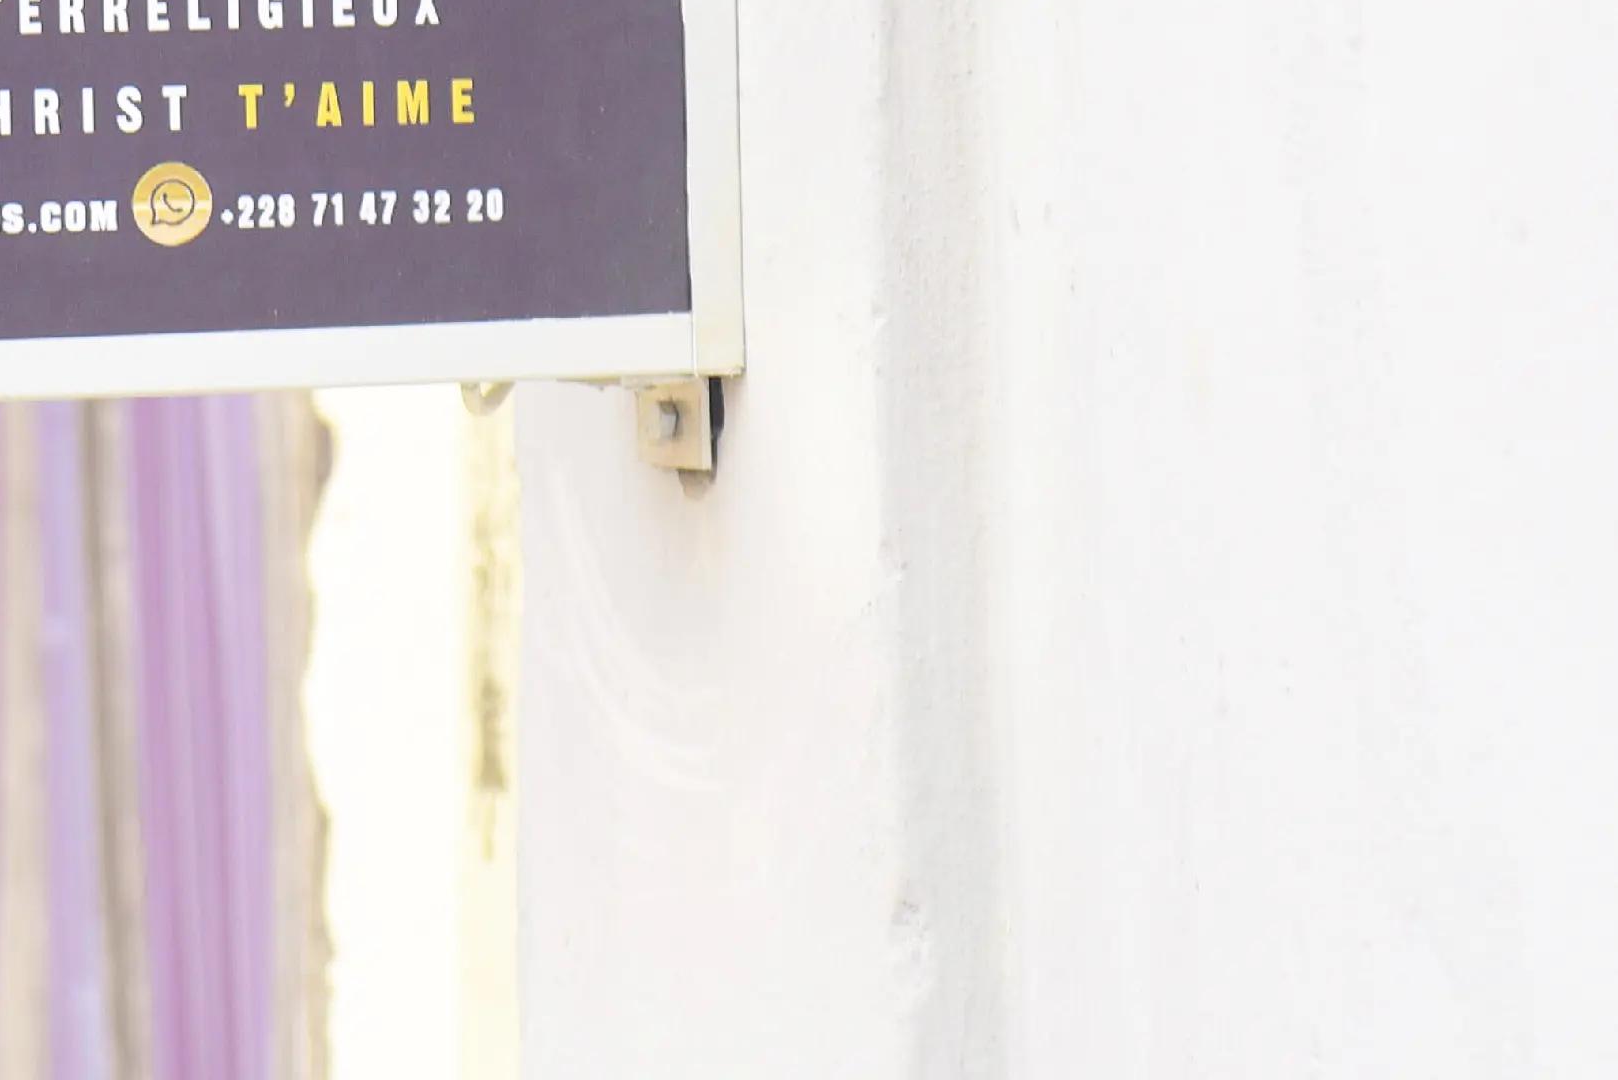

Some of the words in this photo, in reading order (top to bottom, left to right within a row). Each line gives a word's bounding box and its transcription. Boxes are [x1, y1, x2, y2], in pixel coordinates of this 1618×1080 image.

[312, 191, 344, 226] 71
[359, 190, 395, 225] 47
[412, 189, 452, 223] 32
[467, 188, 504, 222] 20
